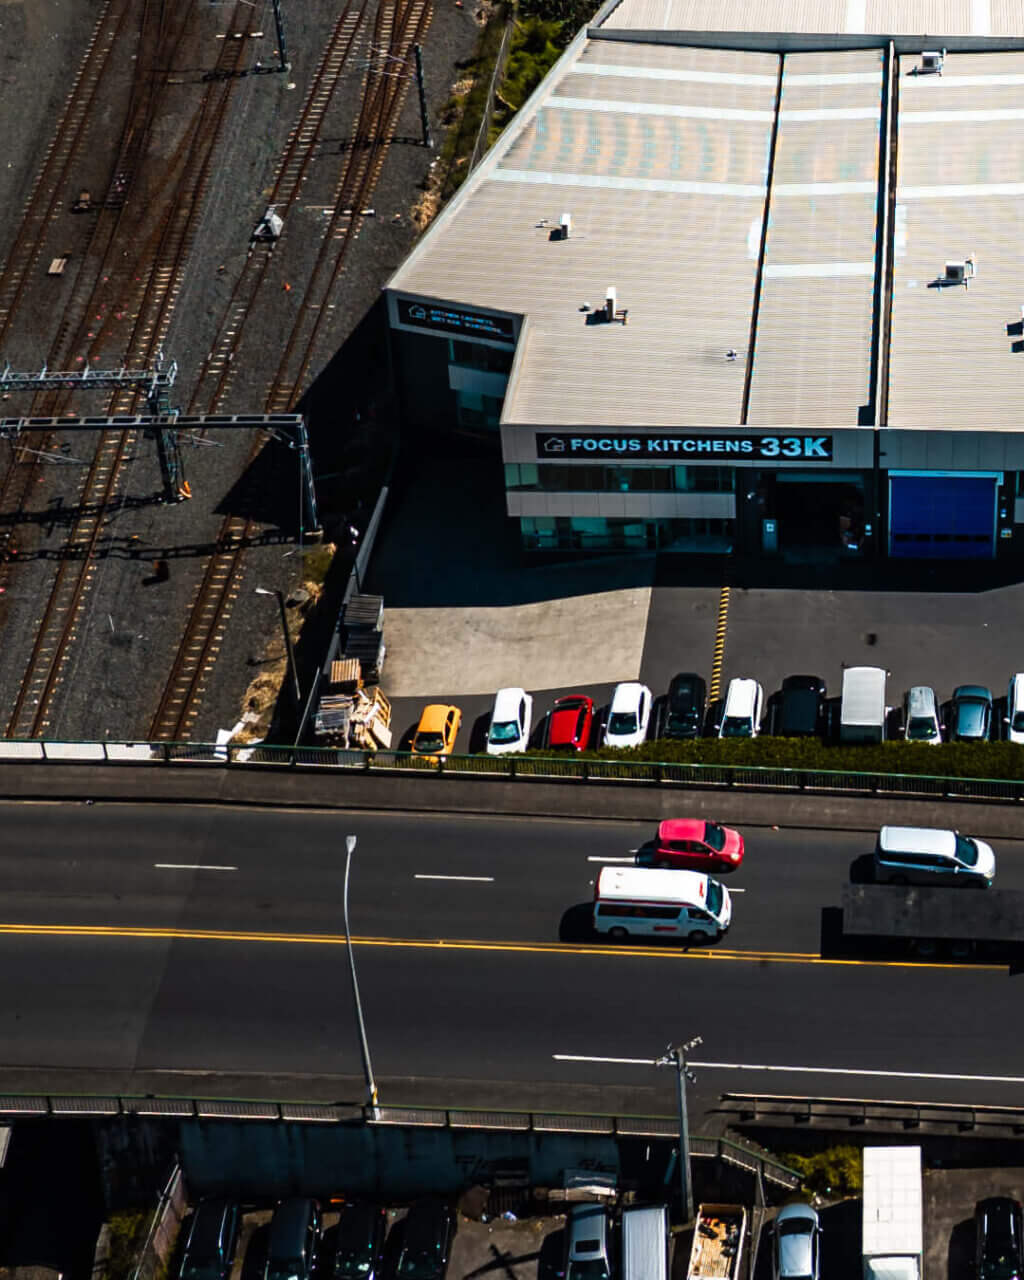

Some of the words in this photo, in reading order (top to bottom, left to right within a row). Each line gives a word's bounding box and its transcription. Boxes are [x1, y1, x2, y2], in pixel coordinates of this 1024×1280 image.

[570, 438, 641, 452] FOCUS
[647, 439, 753, 453] KITCHENS
[760, 437, 829, 457] 33K
